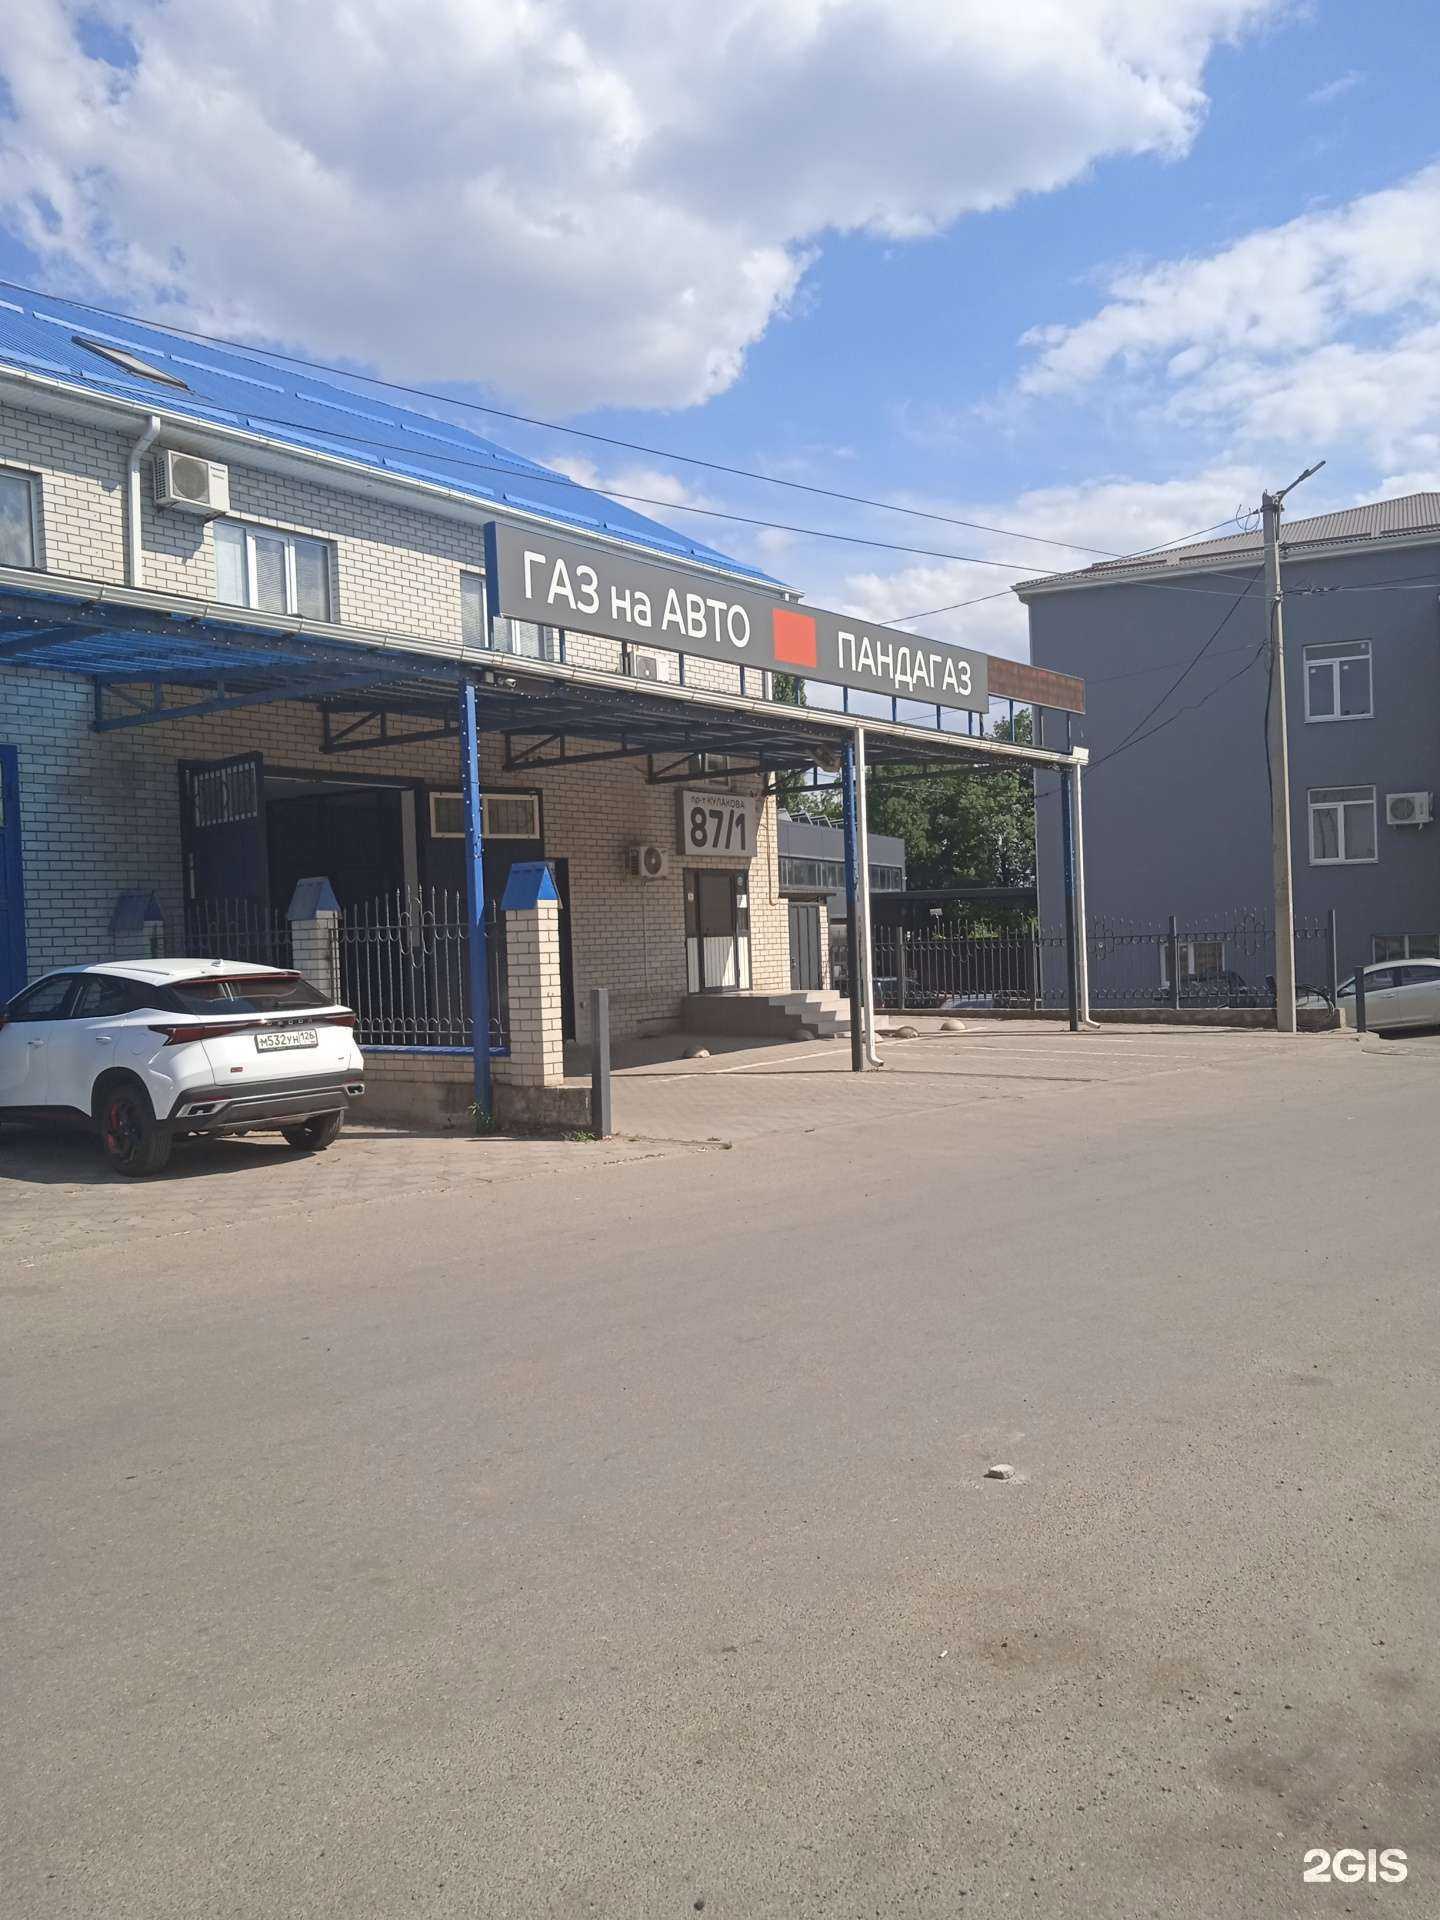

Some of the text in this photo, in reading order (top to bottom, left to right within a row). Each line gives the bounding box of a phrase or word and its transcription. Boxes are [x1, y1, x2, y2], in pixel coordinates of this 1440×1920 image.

[523, 550, 751, 648] ГАЗ на АВТО
[837, 631, 972, 696] ПАНДАГАЗ
[690, 806, 746, 851] 87/1
